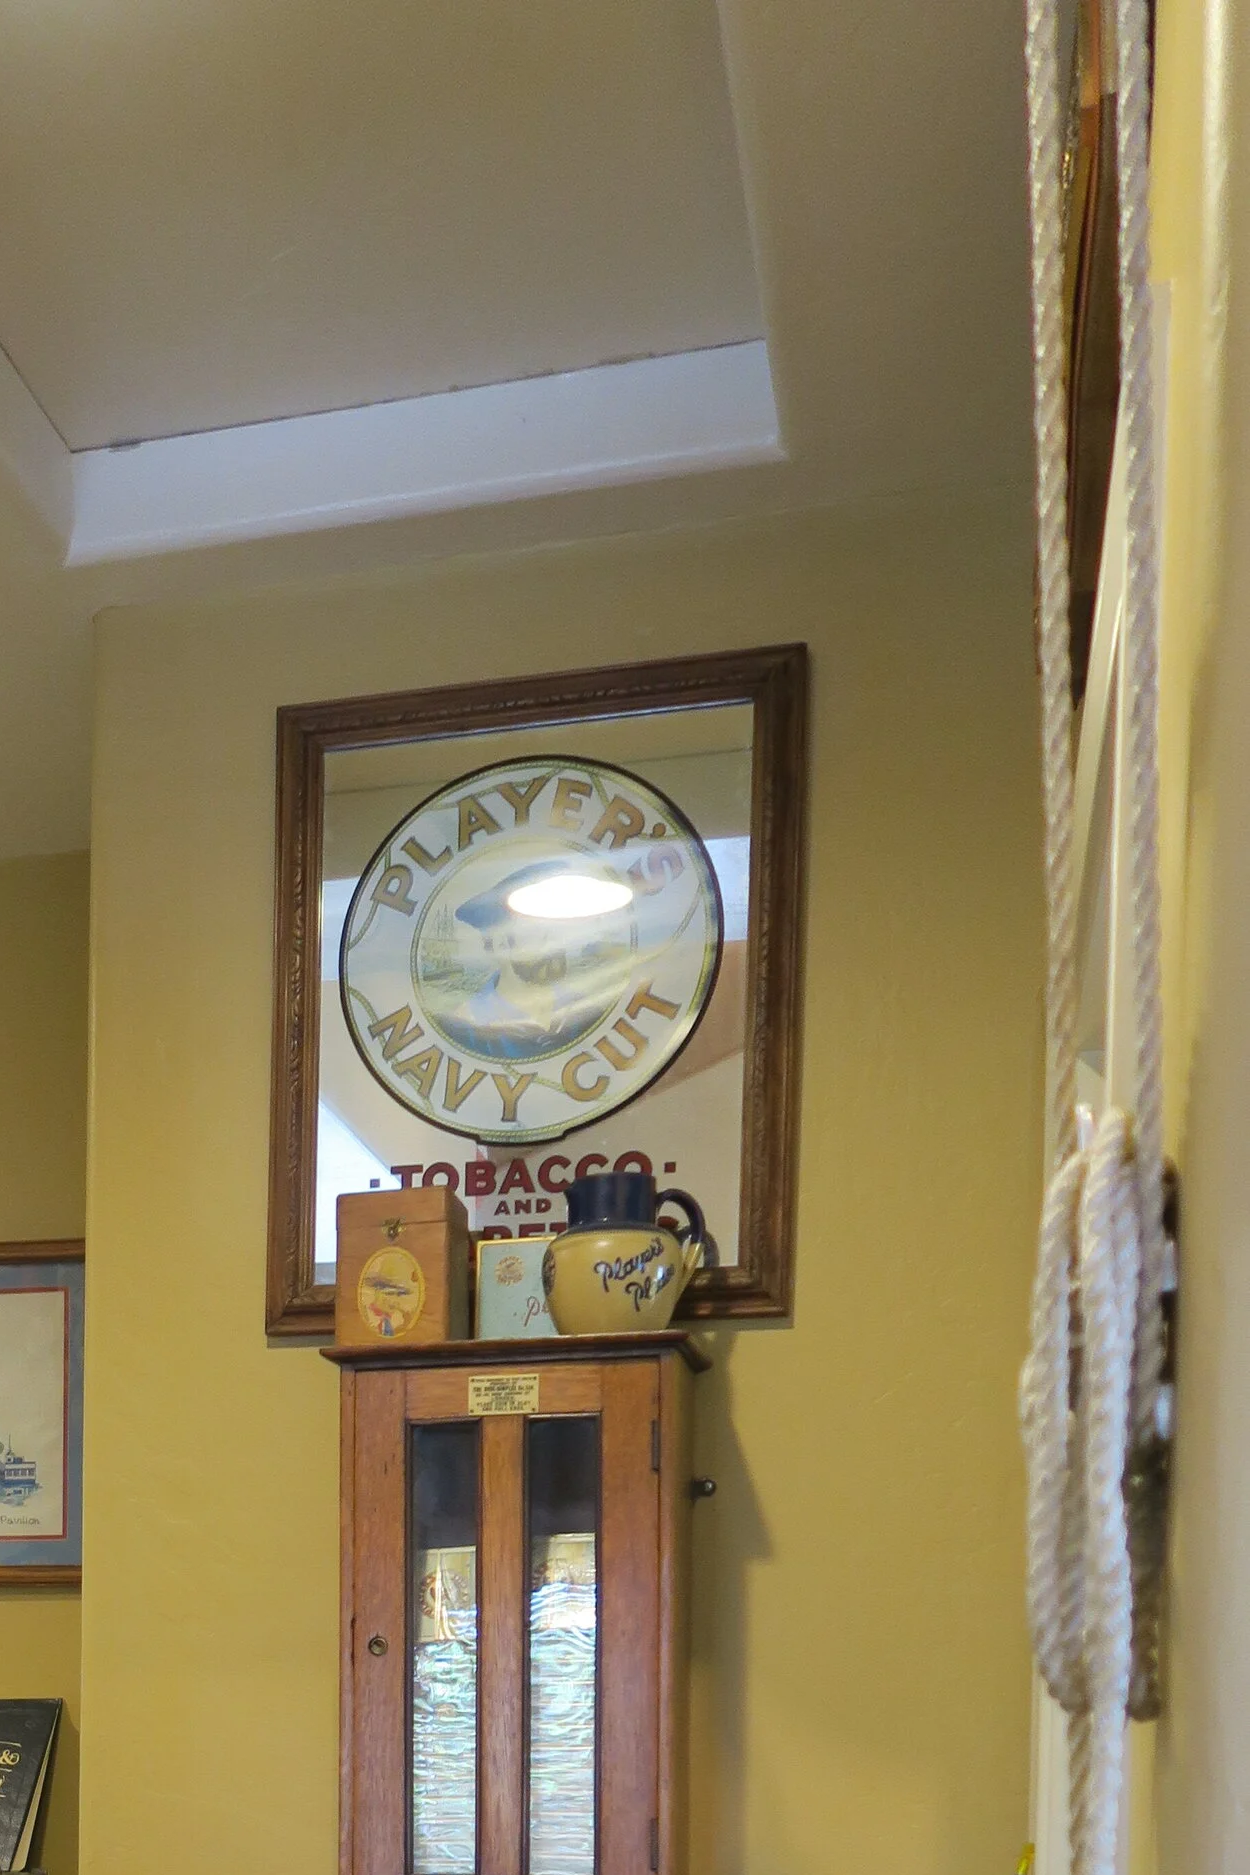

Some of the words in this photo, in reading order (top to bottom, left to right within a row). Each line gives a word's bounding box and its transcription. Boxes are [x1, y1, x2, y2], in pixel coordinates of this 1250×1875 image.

[370, 777, 685, 918] PLAYER'S
[367, 1003, 538, 1123] NAVY
[561, 978, 682, 1103] CUT
[494, 1199, 552, 1217] AND
